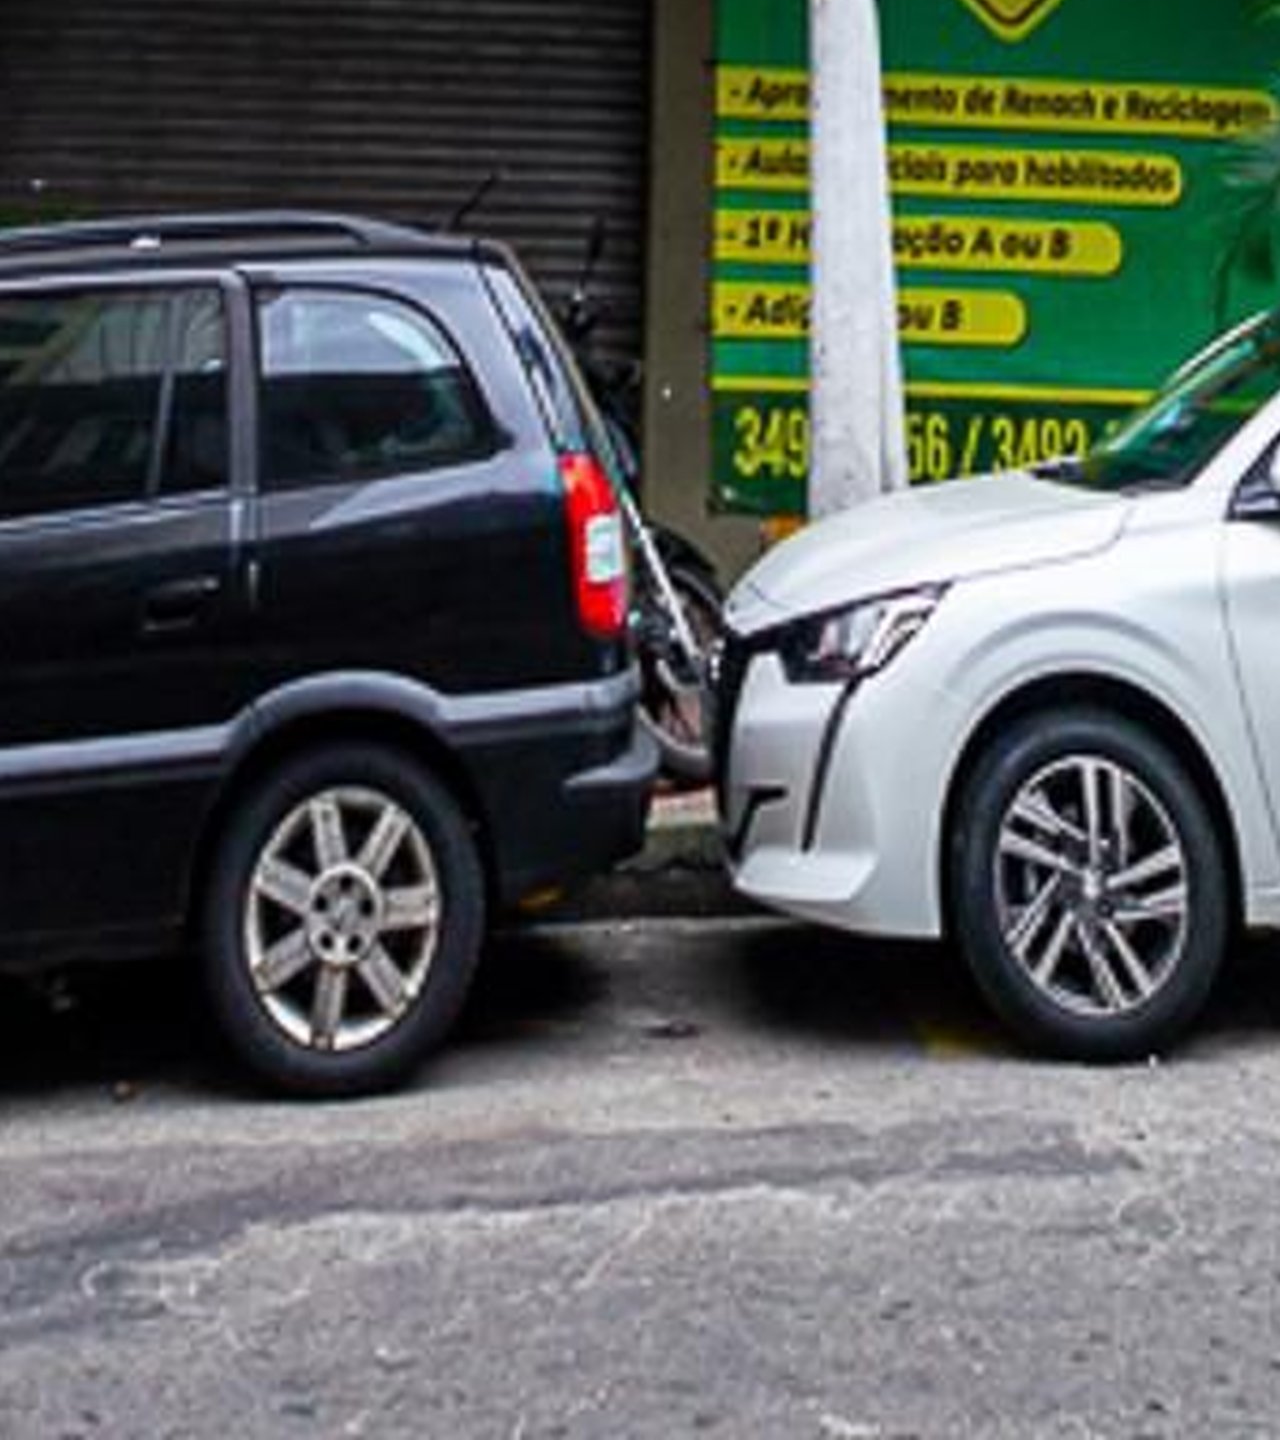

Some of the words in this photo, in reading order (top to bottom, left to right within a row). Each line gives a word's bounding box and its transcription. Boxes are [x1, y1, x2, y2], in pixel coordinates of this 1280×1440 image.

[964, 84, 997, 115] de
[745, 145, 813, 177] Aula
[953, 158, 1018, 189] para
[970, 227, 994, 257] A
[1000, 232, 1042, 260] ou
[1048, 228, 1071, 260] B
[940, 299, 962, 331] B
